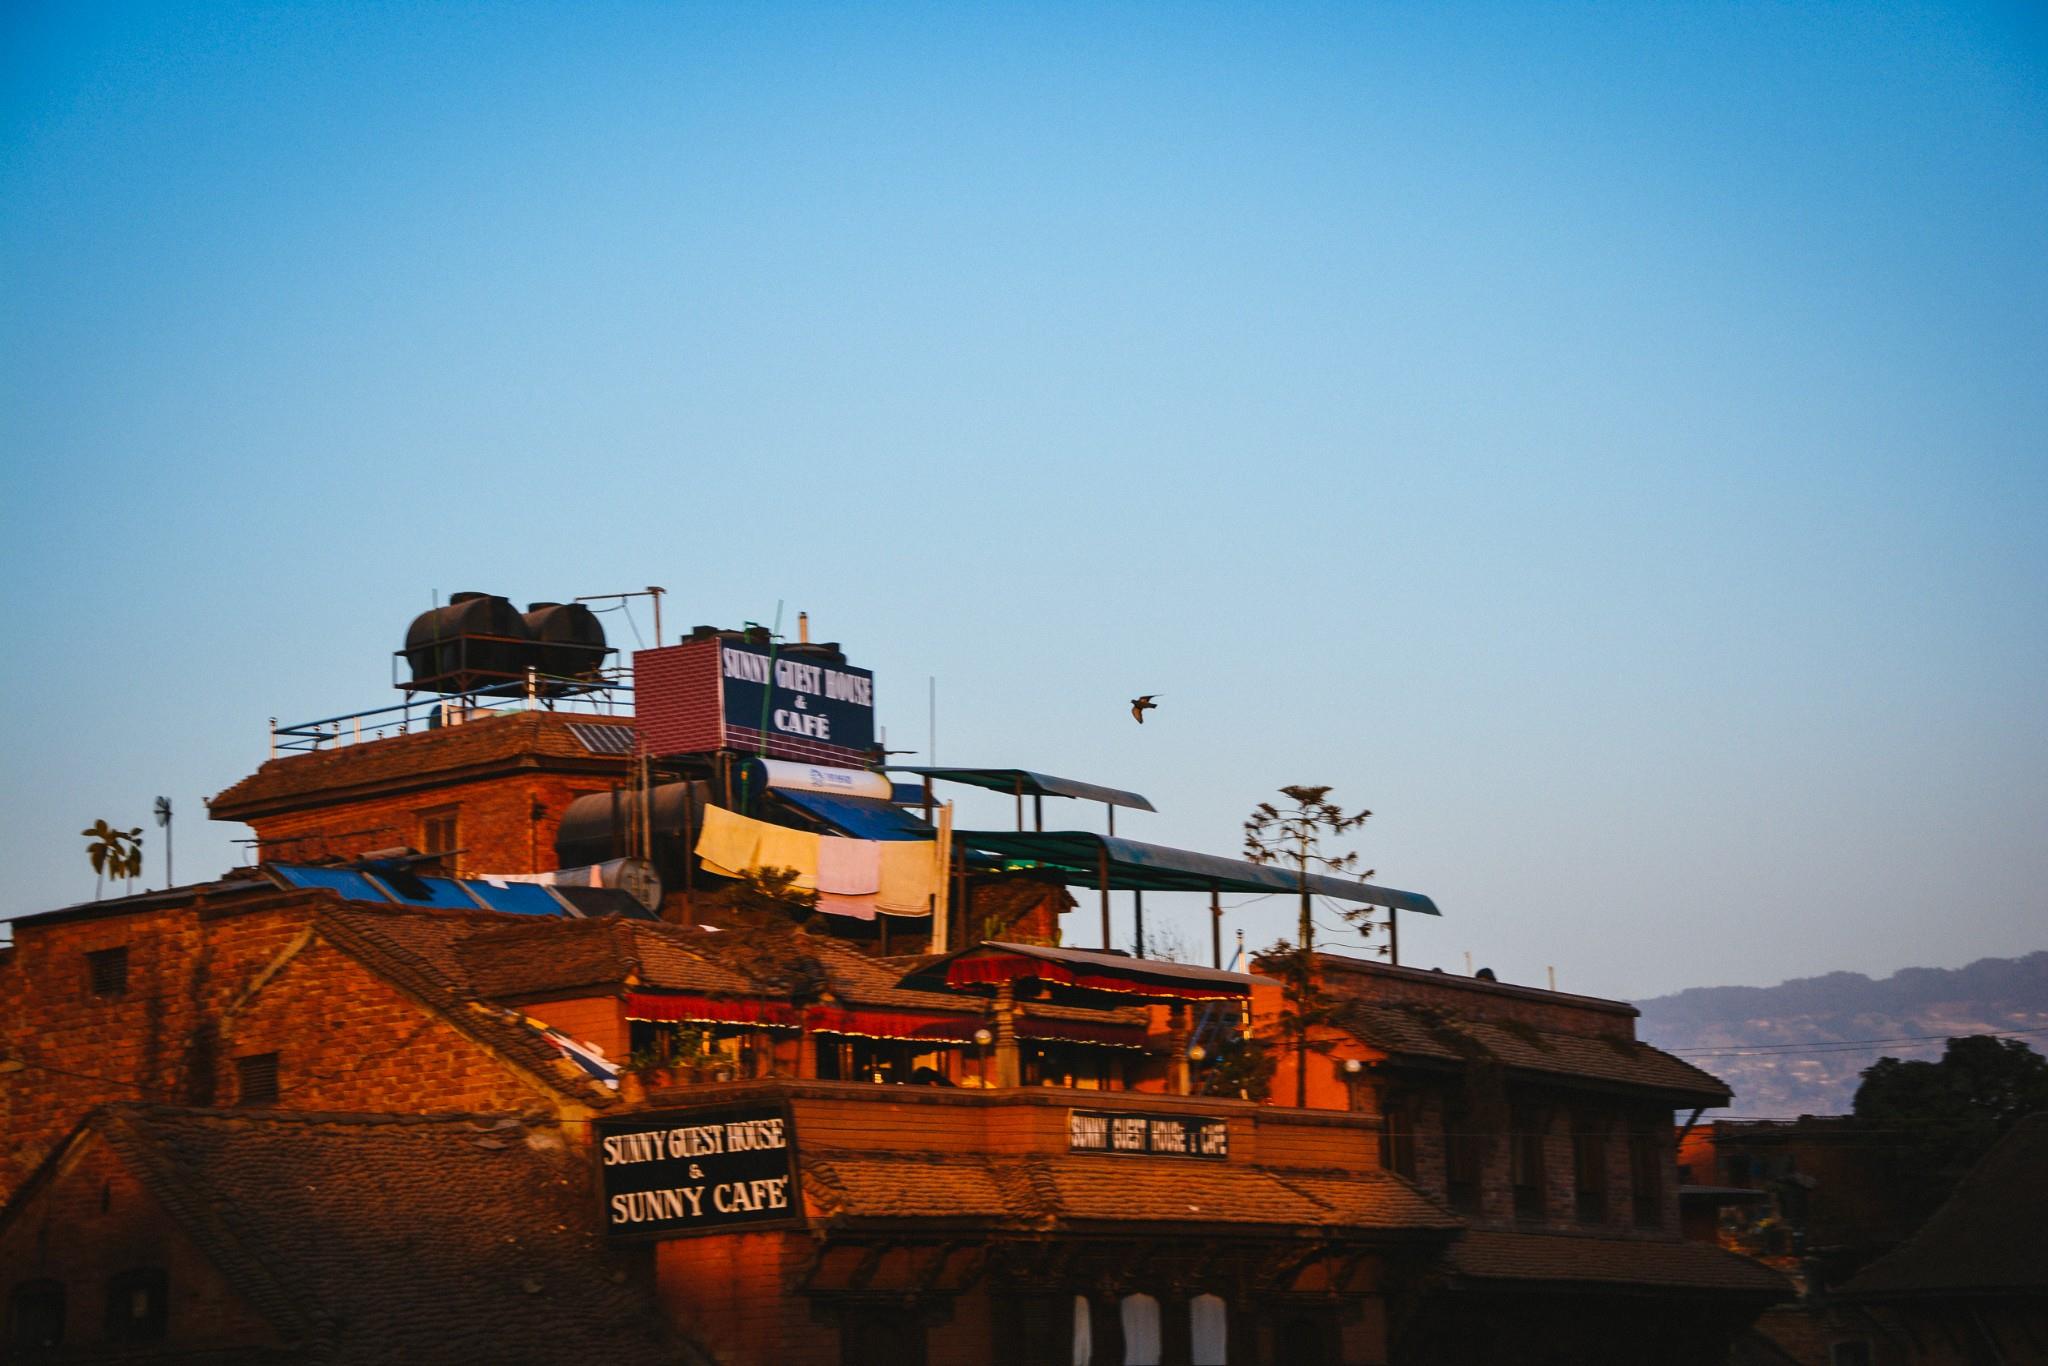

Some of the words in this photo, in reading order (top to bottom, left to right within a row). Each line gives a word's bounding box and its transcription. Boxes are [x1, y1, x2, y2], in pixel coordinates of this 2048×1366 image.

[723, 648, 772, 685] SUNNY
[775, 658, 822, 696] GUEST
[824, 669, 872, 707] HOUSE
[794, 695, 808, 710] &
[773, 708, 831, 740] CAFÉ
[603, 1130, 667, 1166] SUNNY
[668, 1124, 725, 1158] GUEST
[725, 1118, 787, 1153] HOUSE
[689, 1164, 705, 1179] &
[611, 1186, 705, 1225] SUNNY
